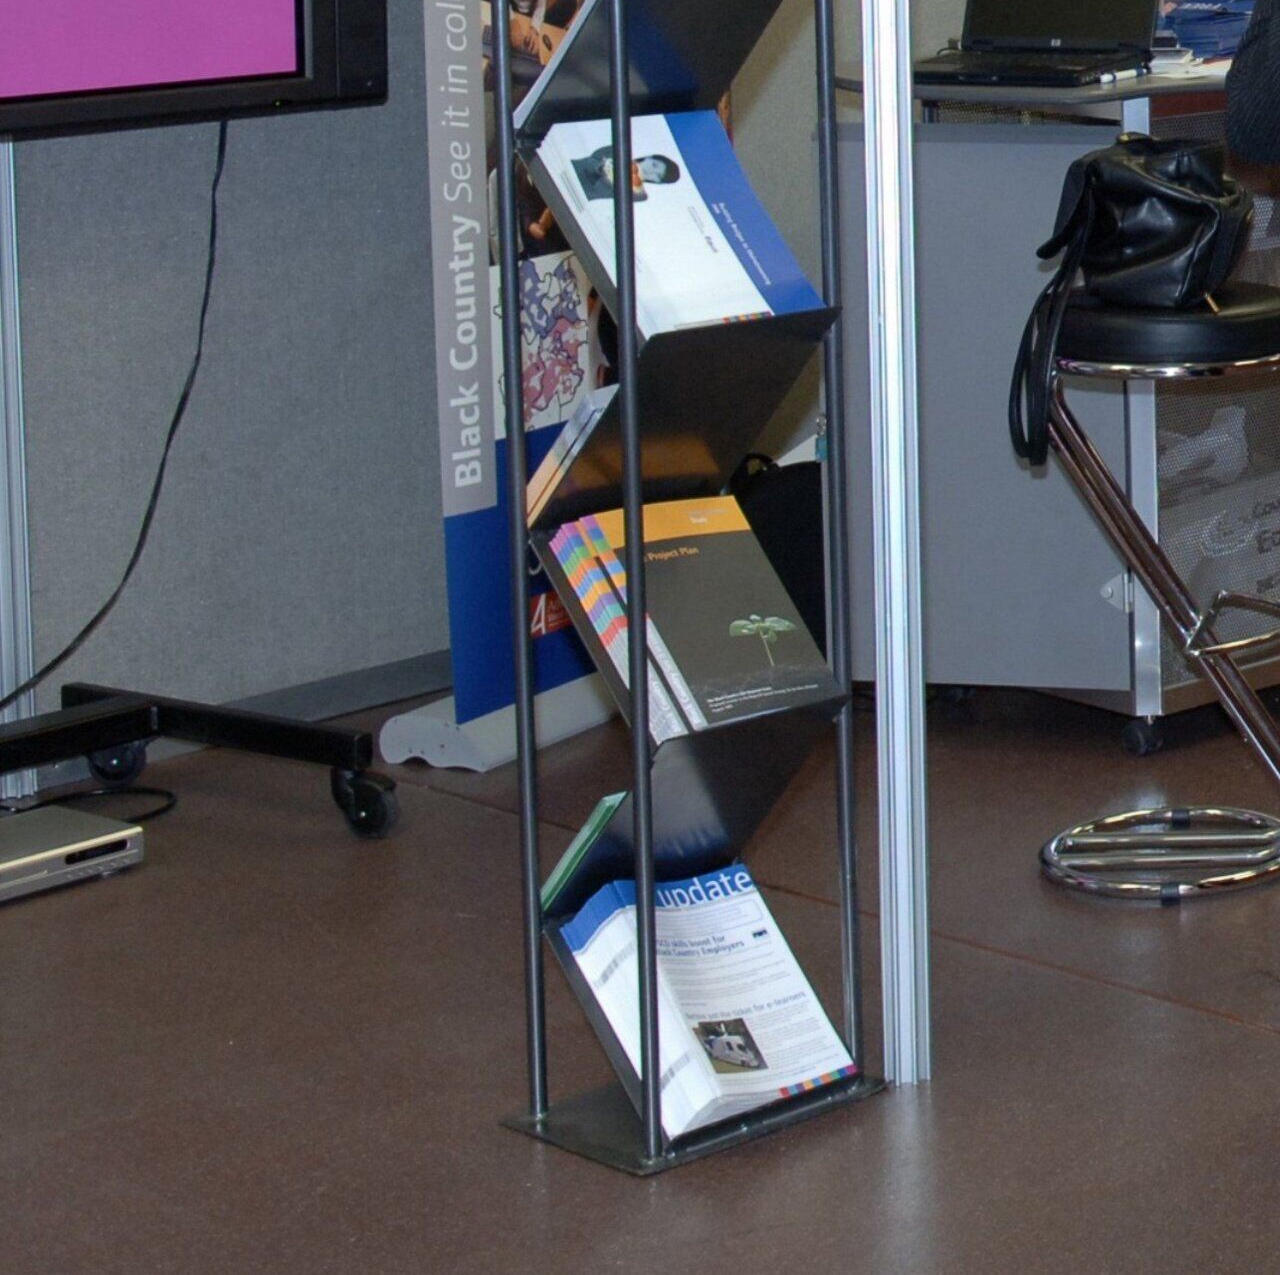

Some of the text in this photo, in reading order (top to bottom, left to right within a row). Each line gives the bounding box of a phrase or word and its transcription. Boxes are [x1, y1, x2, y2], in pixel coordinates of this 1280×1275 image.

[440, 65, 468, 93] in
[441, 107, 470, 128] it
[444, 140, 472, 203] See
[449, 215, 481, 371] Country
[450, 383, 482, 488] Black
[657, 870, 754, 909] update
